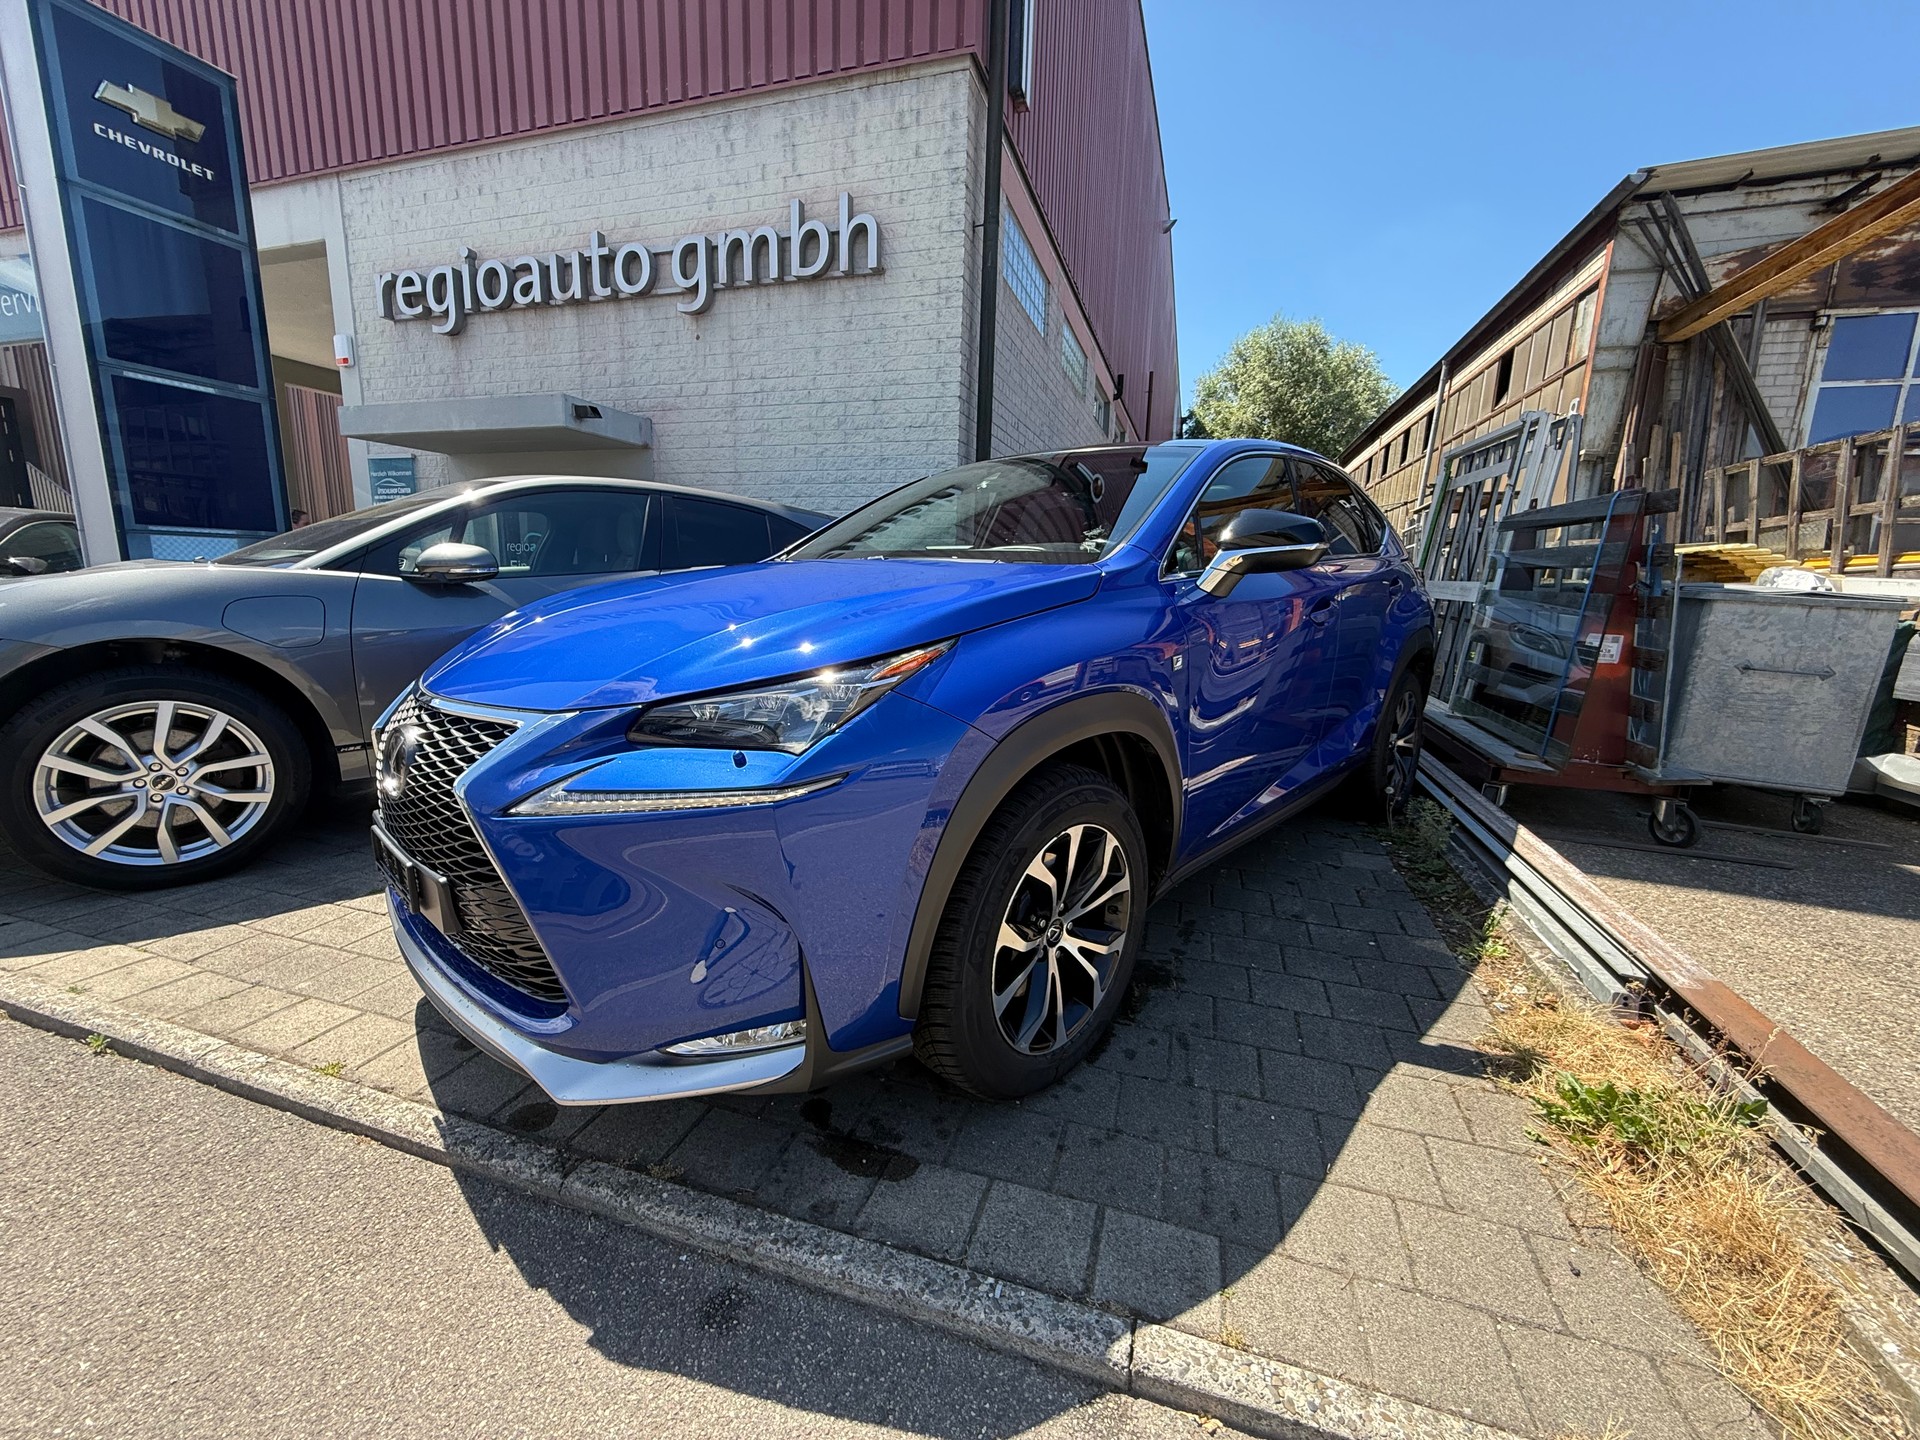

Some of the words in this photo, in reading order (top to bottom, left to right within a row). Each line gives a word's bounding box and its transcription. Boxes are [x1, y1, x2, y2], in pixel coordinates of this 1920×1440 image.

[93, 122, 214, 181] CHEVROLET
[378, 231, 655, 335] regioauto
[672, 191, 883, 314] gmbh
